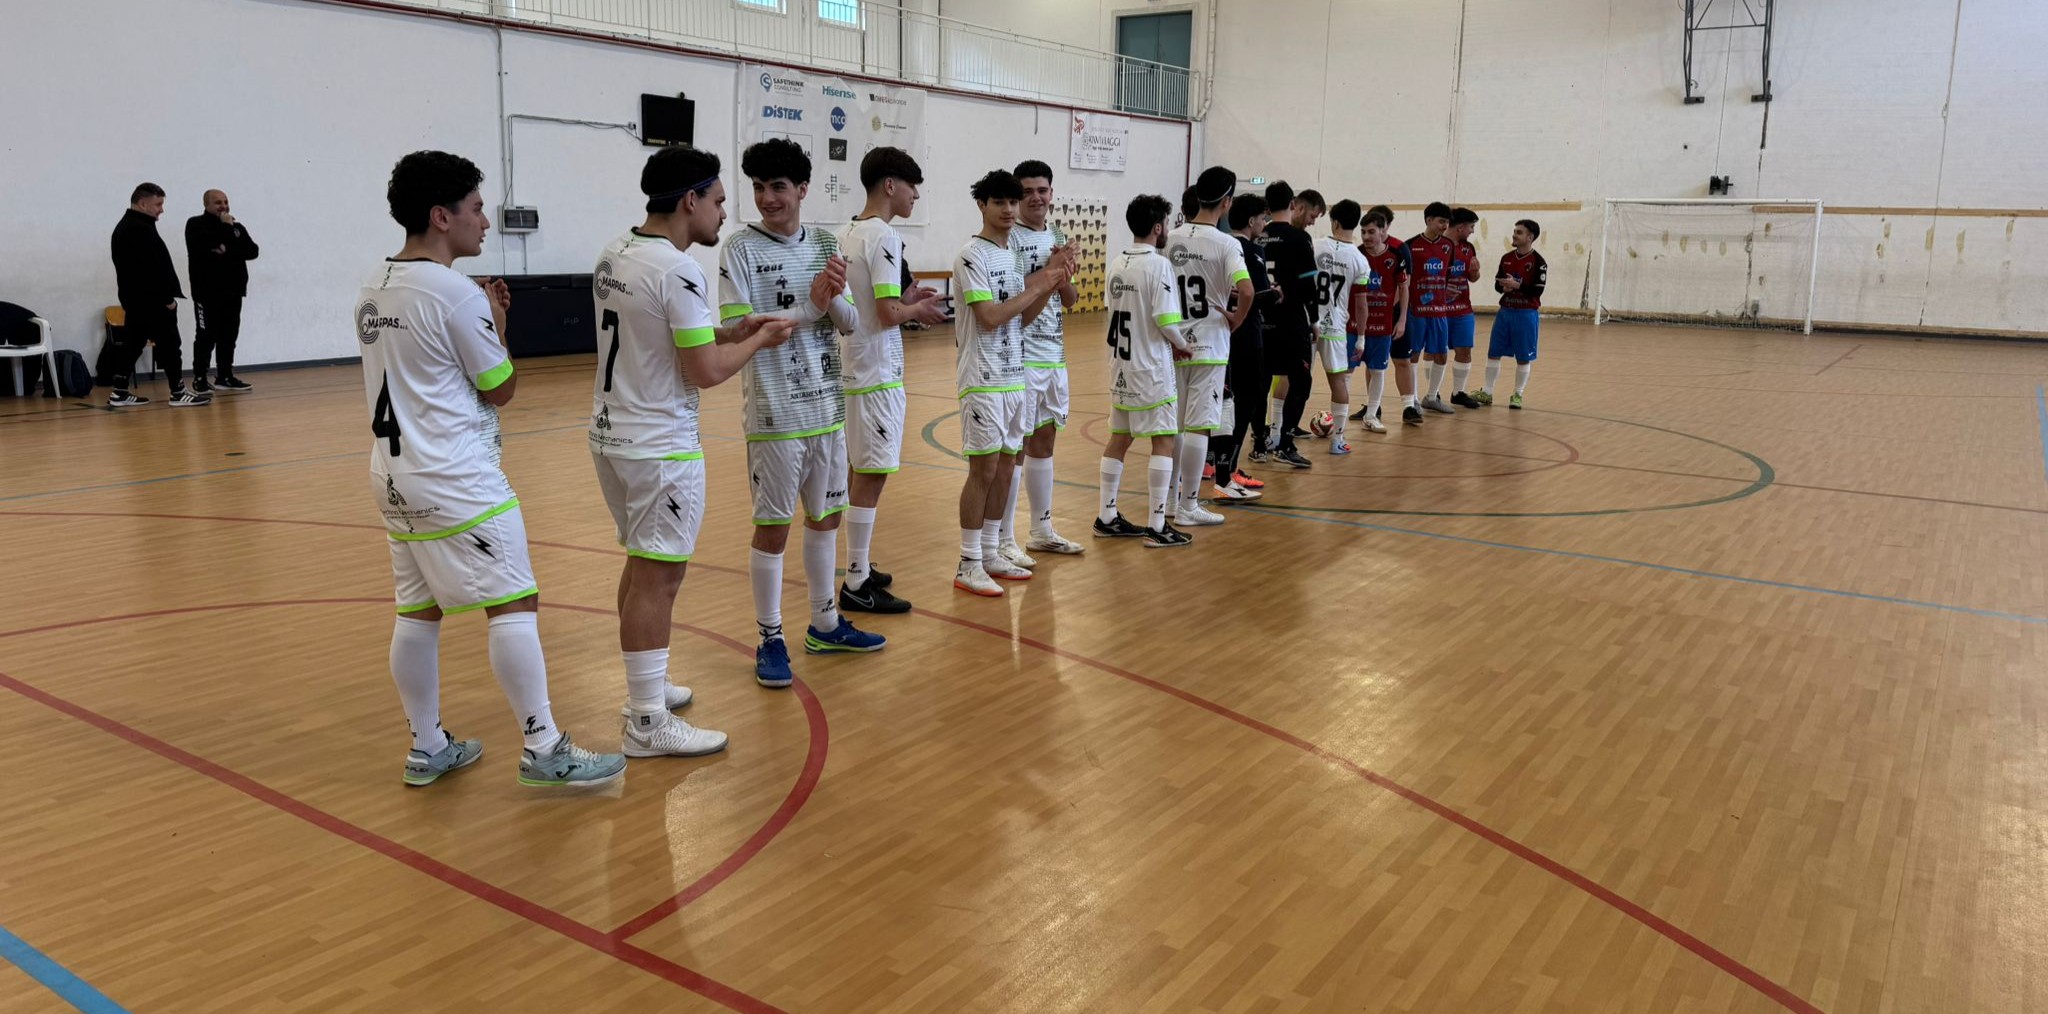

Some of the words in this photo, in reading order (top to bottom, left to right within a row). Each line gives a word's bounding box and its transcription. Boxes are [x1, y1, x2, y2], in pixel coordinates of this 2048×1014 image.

[822, 85, 857, 99] Hisense
[1423, 261, 1444, 270] mcd
[602, 276, 627, 293] MARPAS
[1178, 274, 1209, 320] 13
[1317, 271, 1346, 307] 87
[368, 317, 400, 329] MARPAS
[1107, 310, 1131, 361] 45
[602, 308, 620, 392] 7
[371, 368, 401, 457] 4
